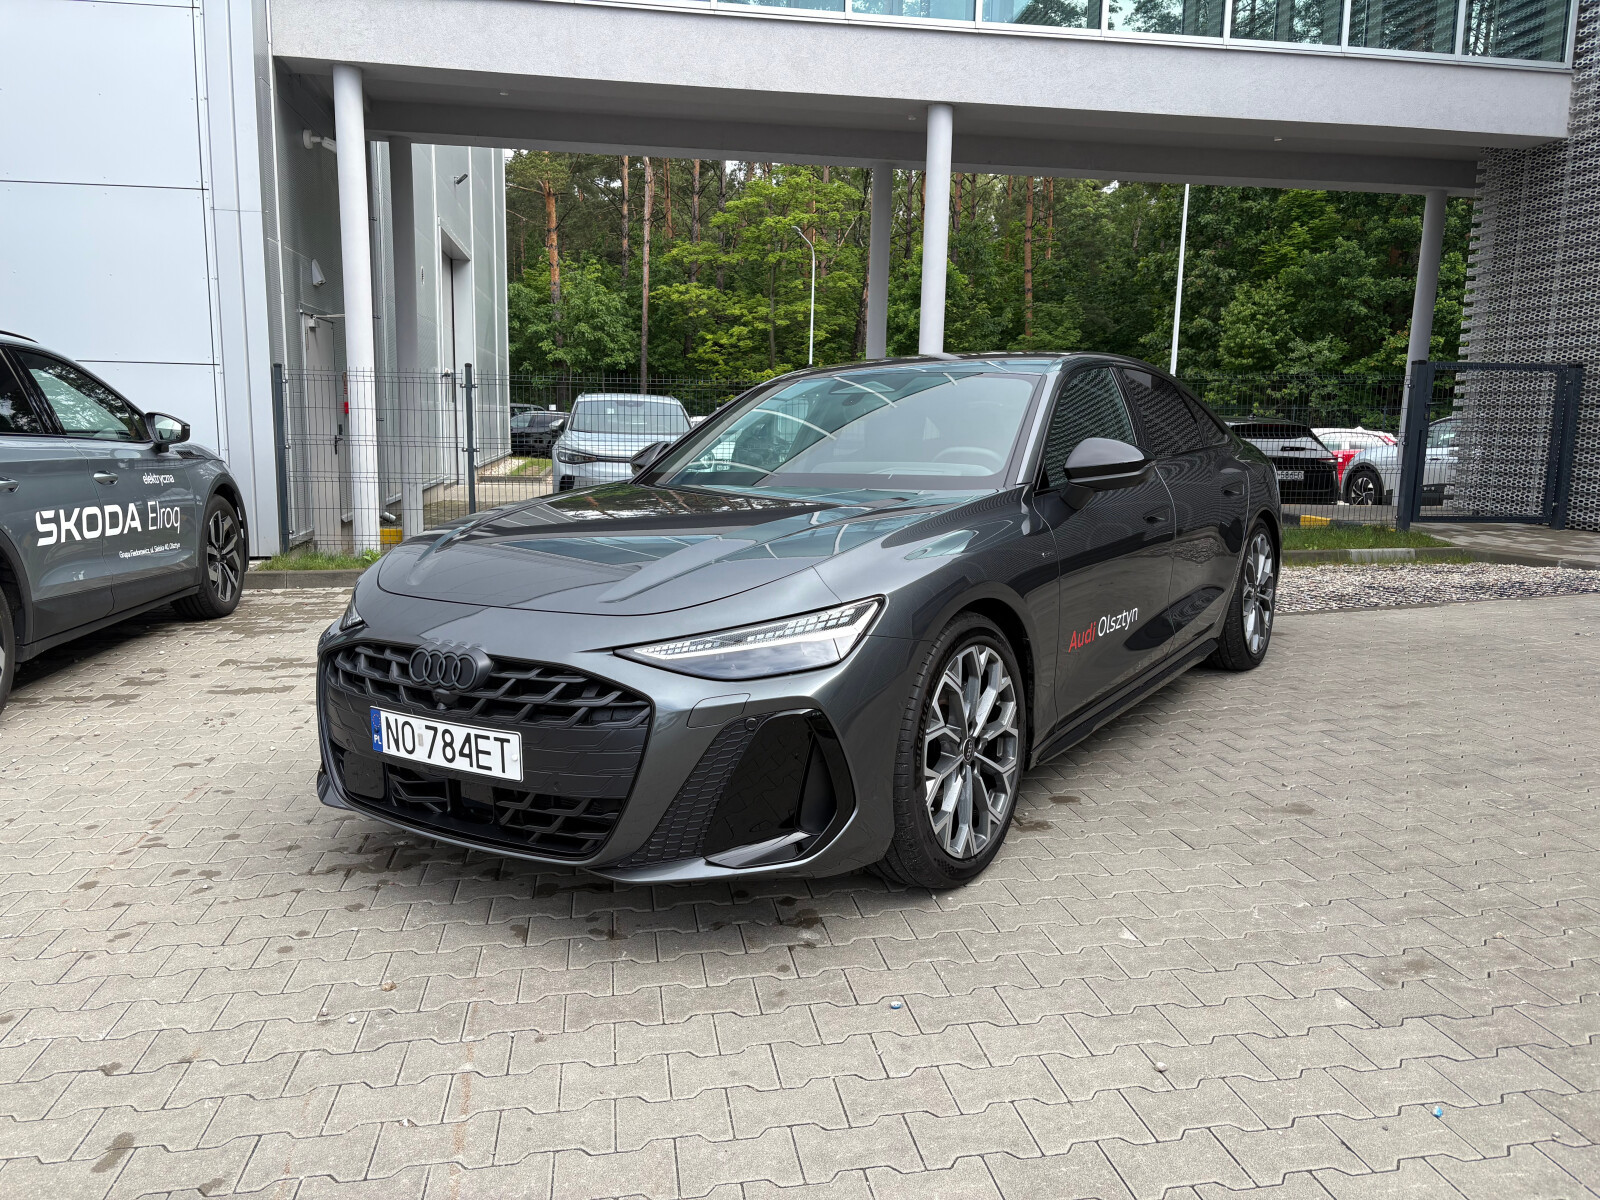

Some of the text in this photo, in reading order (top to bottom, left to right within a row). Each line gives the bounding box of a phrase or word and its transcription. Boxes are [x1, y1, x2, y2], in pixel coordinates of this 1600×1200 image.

[142, 472, 175, 487] elektryczna
[147, 501, 181, 534] Elroq
[1068, 607, 1138, 653] Audi Olsztyn
[373, 716, 511, 774] PL NO 784ET
